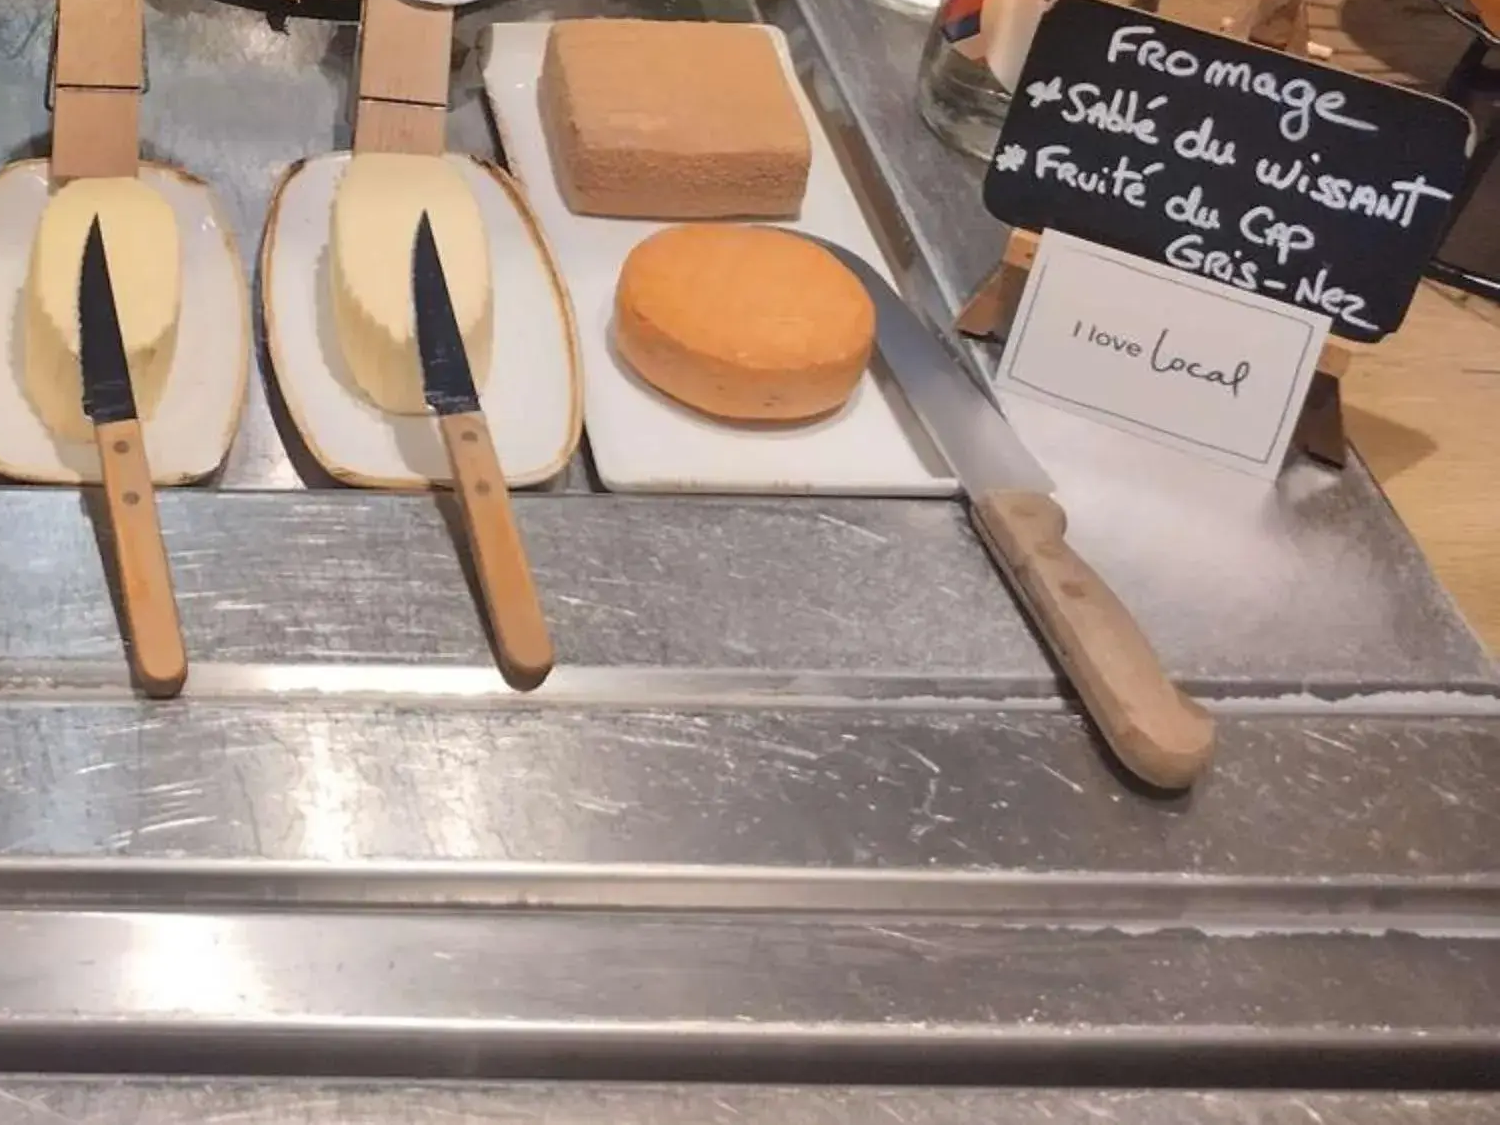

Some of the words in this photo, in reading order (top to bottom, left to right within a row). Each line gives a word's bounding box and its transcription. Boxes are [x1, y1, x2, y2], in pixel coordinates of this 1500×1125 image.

[1173, 116, 1237, 166] du
[1164, 185, 1221, 229] du
[1087, 323, 1143, 358] love
